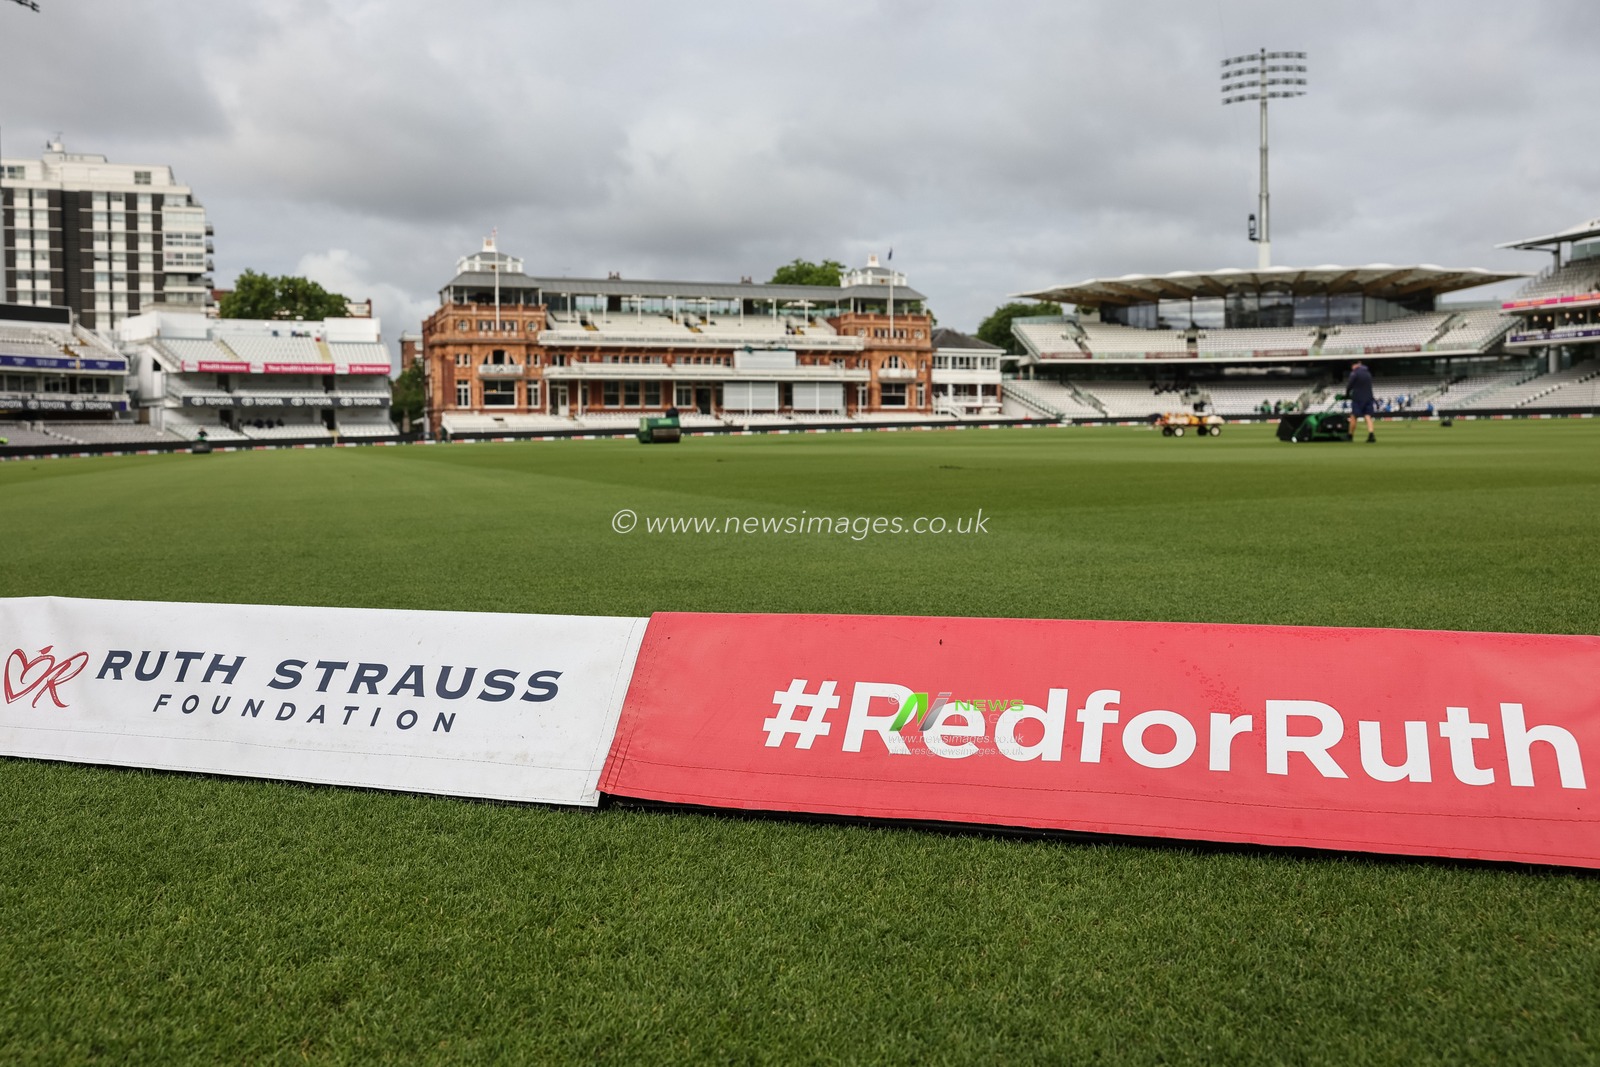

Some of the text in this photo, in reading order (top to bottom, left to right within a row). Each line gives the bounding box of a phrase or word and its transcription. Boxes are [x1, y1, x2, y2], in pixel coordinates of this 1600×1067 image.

[40, 401, 66, 409] TOYOTA
[84, 401, 112, 410] TOYOTA
[205, 397, 234, 405] TOYOTA
[255, 397, 283, 405] TOYOTA
[96, 649, 564, 703] RUTH STRAUSS
[153, 693, 457, 733] FOUNDATION
[762, 677, 1587, 790] #RedforRuth
